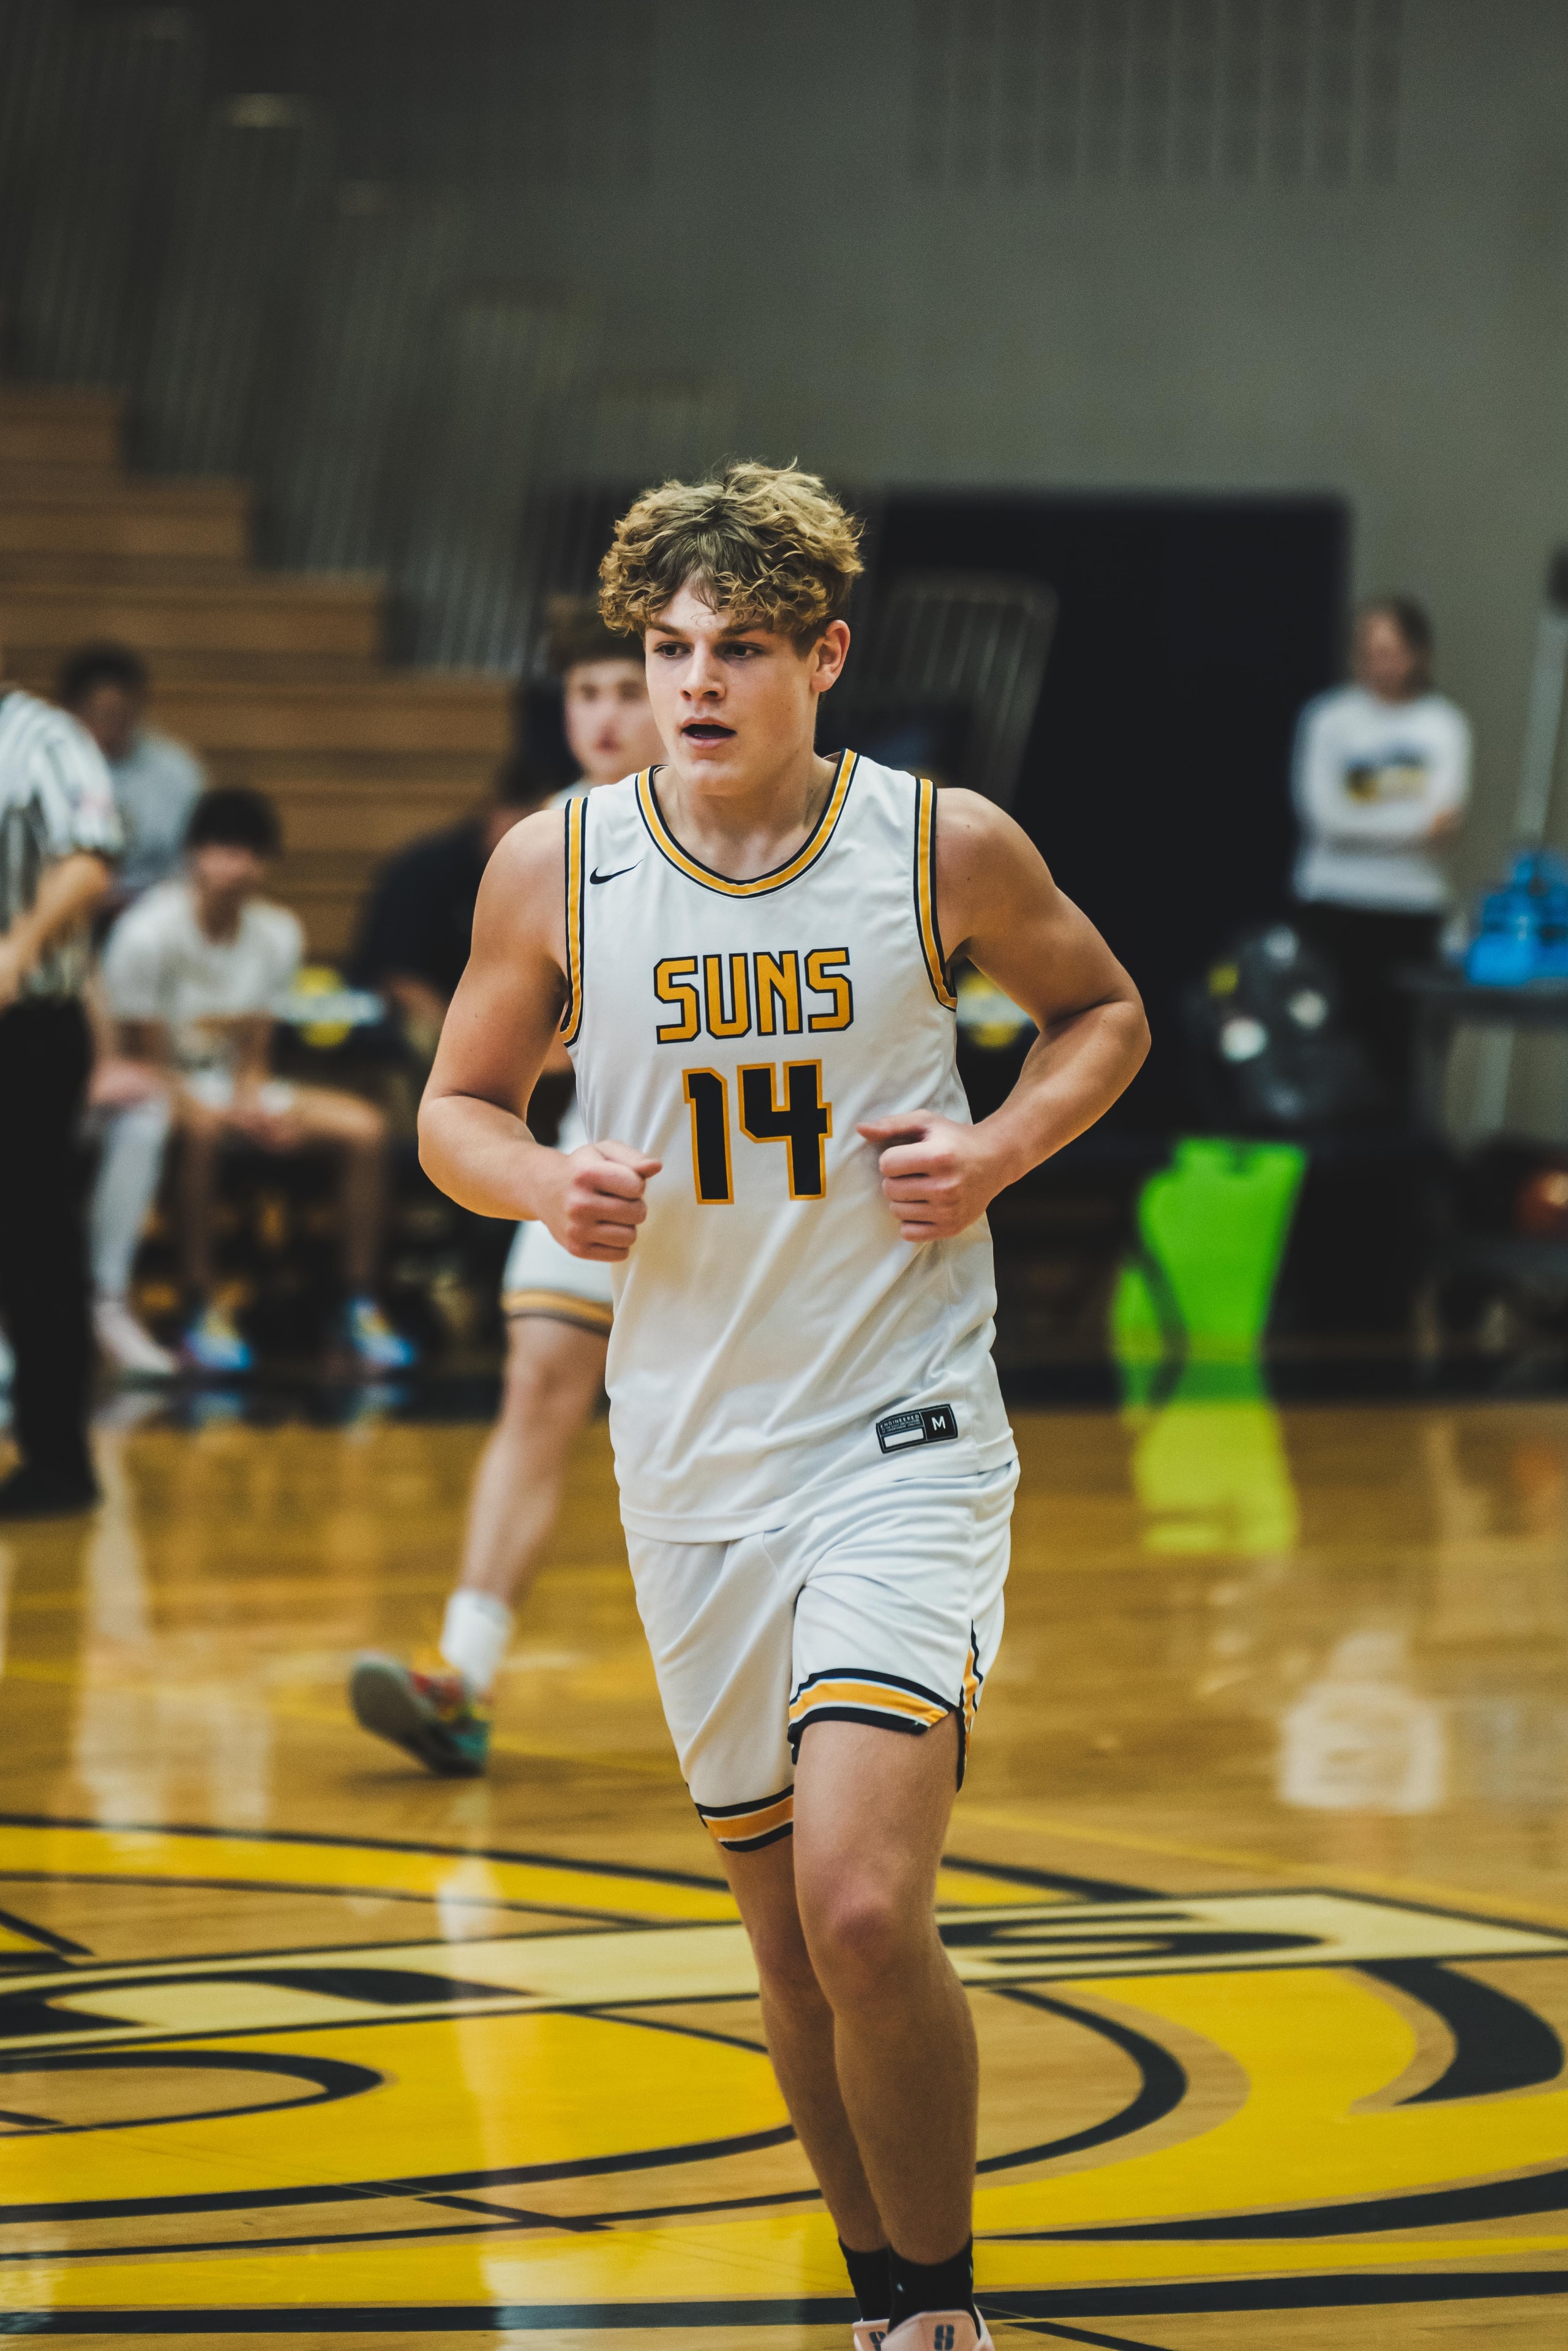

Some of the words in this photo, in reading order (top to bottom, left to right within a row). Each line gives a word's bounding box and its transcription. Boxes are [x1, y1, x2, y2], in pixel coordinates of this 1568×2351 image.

[654, 947, 853, 1044] SUNS
[682, 1059, 832, 1204] 14
[880, 1414, 919, 1428] ENGINEERED
[931, 1415, 945, 1430] M
